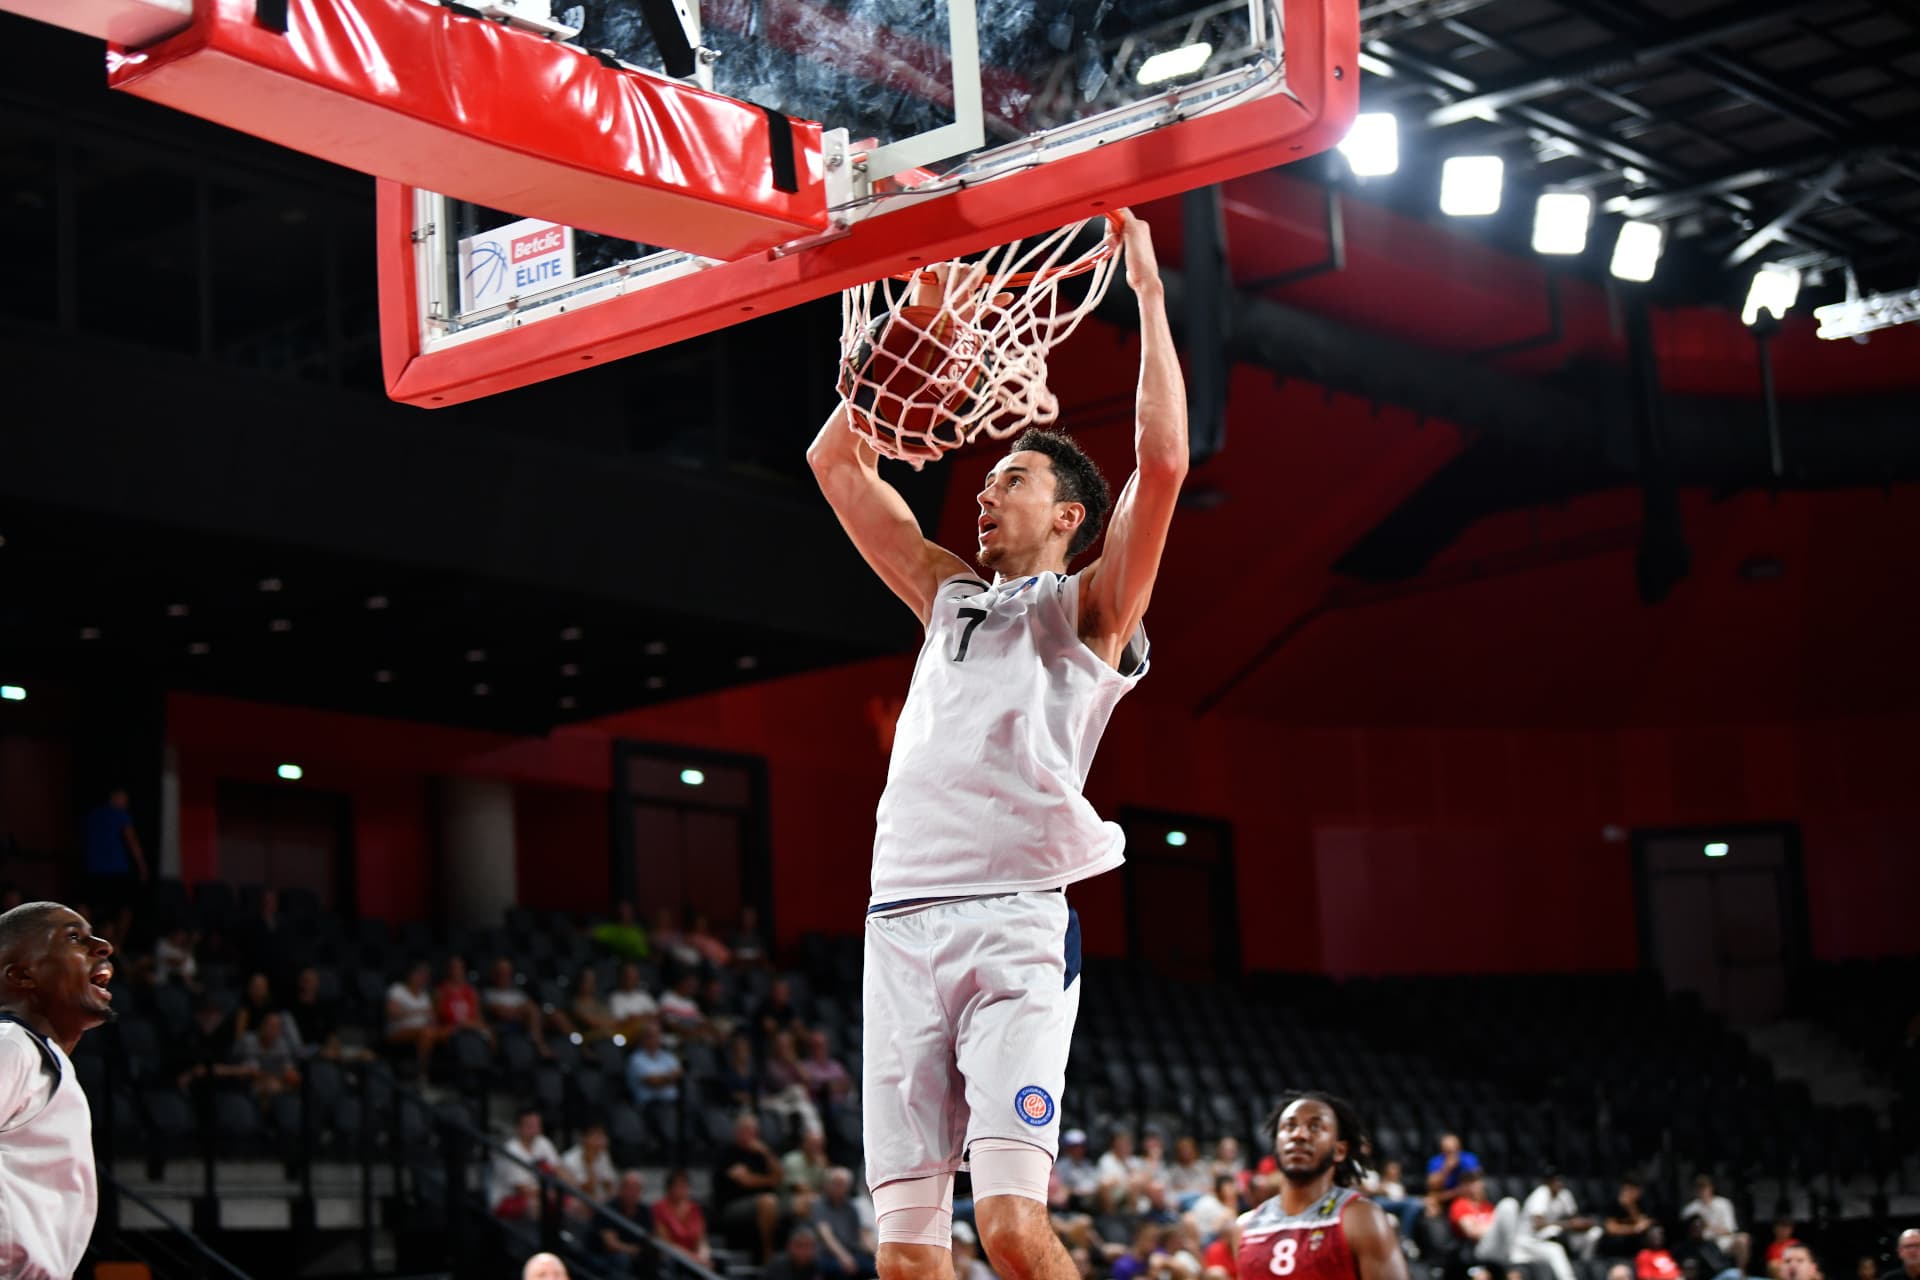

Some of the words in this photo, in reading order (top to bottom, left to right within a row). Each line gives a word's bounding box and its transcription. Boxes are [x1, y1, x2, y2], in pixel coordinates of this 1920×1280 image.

[514, 231, 561, 259] Betclic
[516, 258, 561, 288] ÉLITE
[953, 607, 987, 662] 7
[1269, 1237, 1298, 1276] 8
